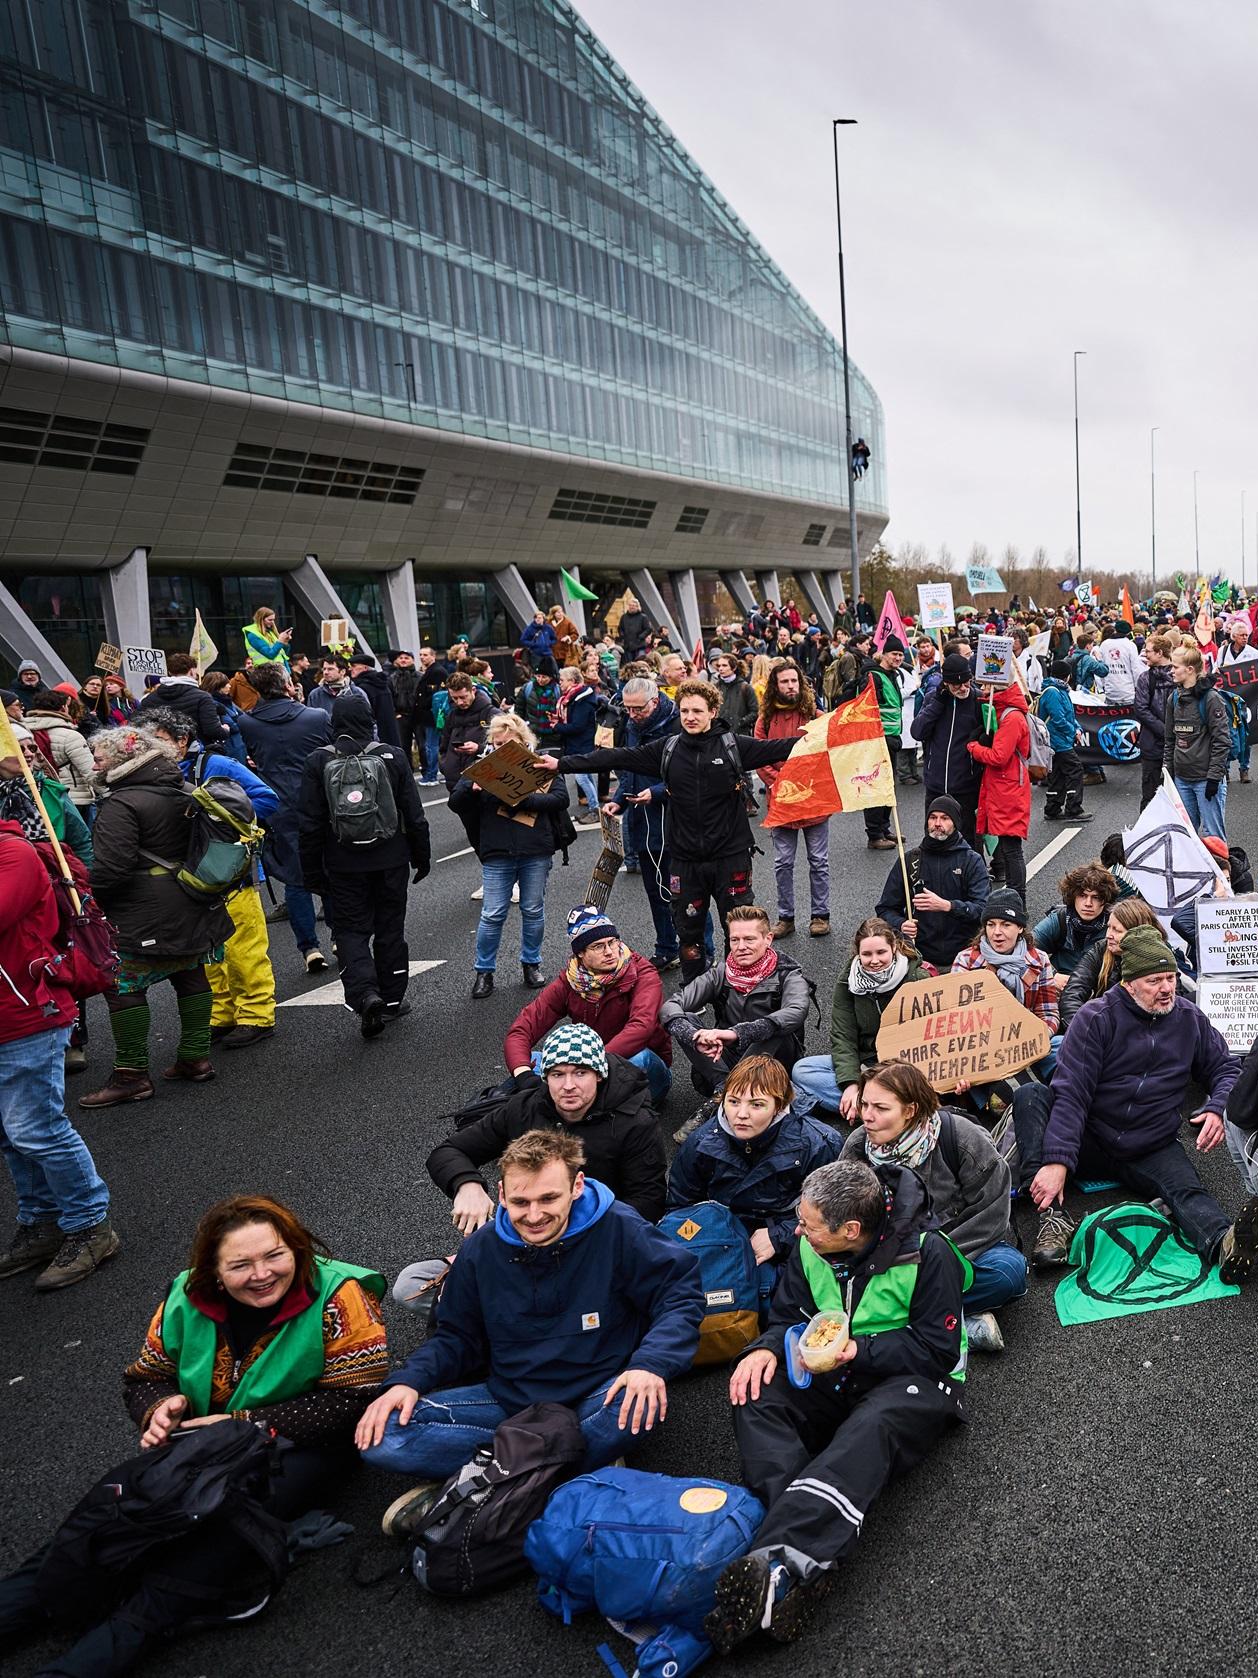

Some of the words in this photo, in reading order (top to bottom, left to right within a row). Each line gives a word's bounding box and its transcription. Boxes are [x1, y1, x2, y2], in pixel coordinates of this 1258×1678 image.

[127, 648, 163, 663] STOP
[1215, 908, 1241, 916] NEARLY
[1222, 921, 1252, 929] CLIMATE
[1241, 933, 1257, 941] ING
[898, 990, 944, 1025] LAAT
[958, 982, 986, 1007] DE
[923, 1007, 994, 1041] LEEUW
[900, 1043, 940, 1064] MAAR
[948, 1031, 990, 1053] EVEN
[1000, 1022, 1022, 1042] IN
[928, 1052, 990, 1081] HEMPIE
